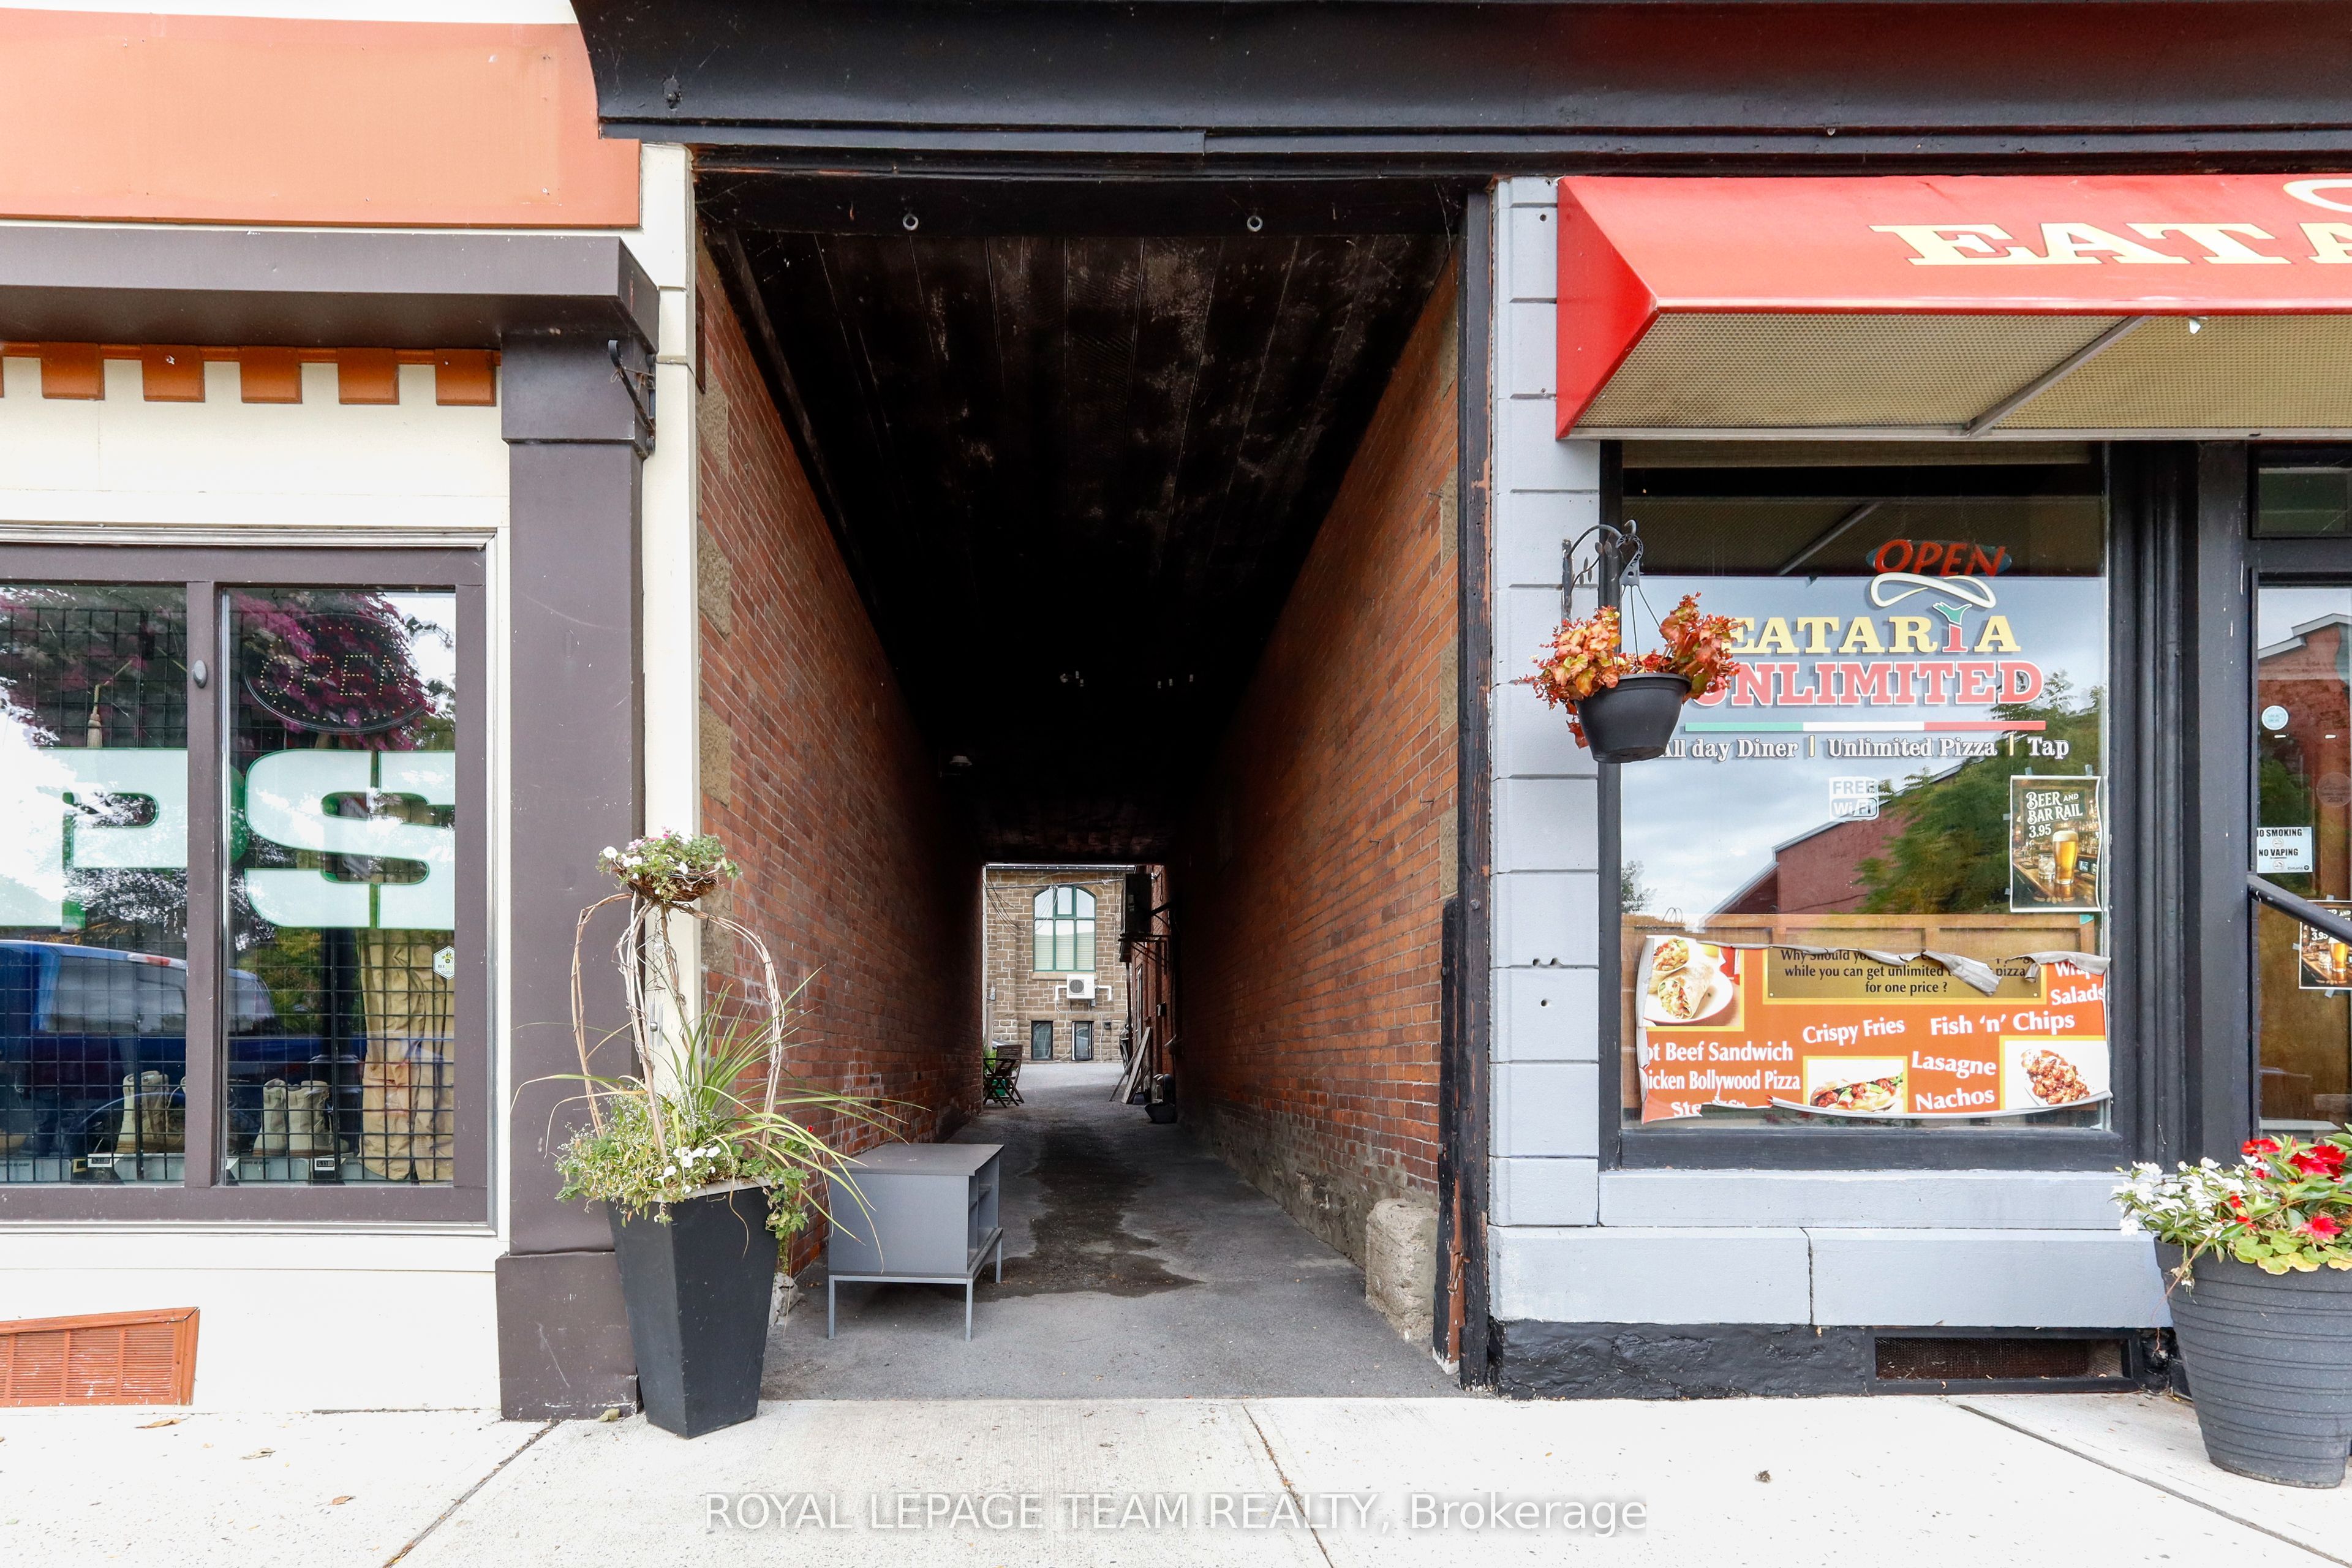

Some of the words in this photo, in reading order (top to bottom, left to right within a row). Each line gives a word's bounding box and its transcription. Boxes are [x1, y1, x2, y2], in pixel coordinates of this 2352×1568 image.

[1873, 539, 2006, 576] OPEN
[260, 655, 409, 696] OPEN
[1692, 738, 1731, 761] day
[1737, 738, 1799, 758] Diner
[1827, 737, 1933, 758] Unlimited
[1939, 737, 1998, 758] Pizza
[2027, 736, 2070, 760] Tap
[1833, 780, 1874, 794] FREE
[2026, 791, 2063, 810] BEER
[2062, 793, 2079, 802] AND
[2027, 805, 2055, 824] BAR
[2055, 803, 2083, 821] RAIL
[2029, 823, 2052, 839] 3.95
[1853, 952, 1873, 963] yo
[1784, 965, 1815, 977] while
[1819, 968, 1839, 981] you
[1844, 968, 1863, 977] can
[1867, 966, 1884, 981] get
[1888, 964, 1944, 977] unlimited
[1865, 982, 1882, 993] for
[1885, 984, 1908, 993] one
[1910, 982, 1939, 996] price
[1803, 1023, 1858, 1046] Crispy
[1863, 1017, 1905, 1037] Fries
[1930, 1015, 1972, 1036] Fish
[2013, 1011, 2075, 1036] Chips
[1665, 1041, 1704, 1061] Beef
[1708, 1041, 1793, 1061] Sandwich
[1912, 1050, 1997, 1079] Lasagne
[1689, 1069, 1761, 1093] Bollywood
[1765, 1069, 1801, 1090] Pizza
[1915, 1087, 1996, 1111] Nachos
